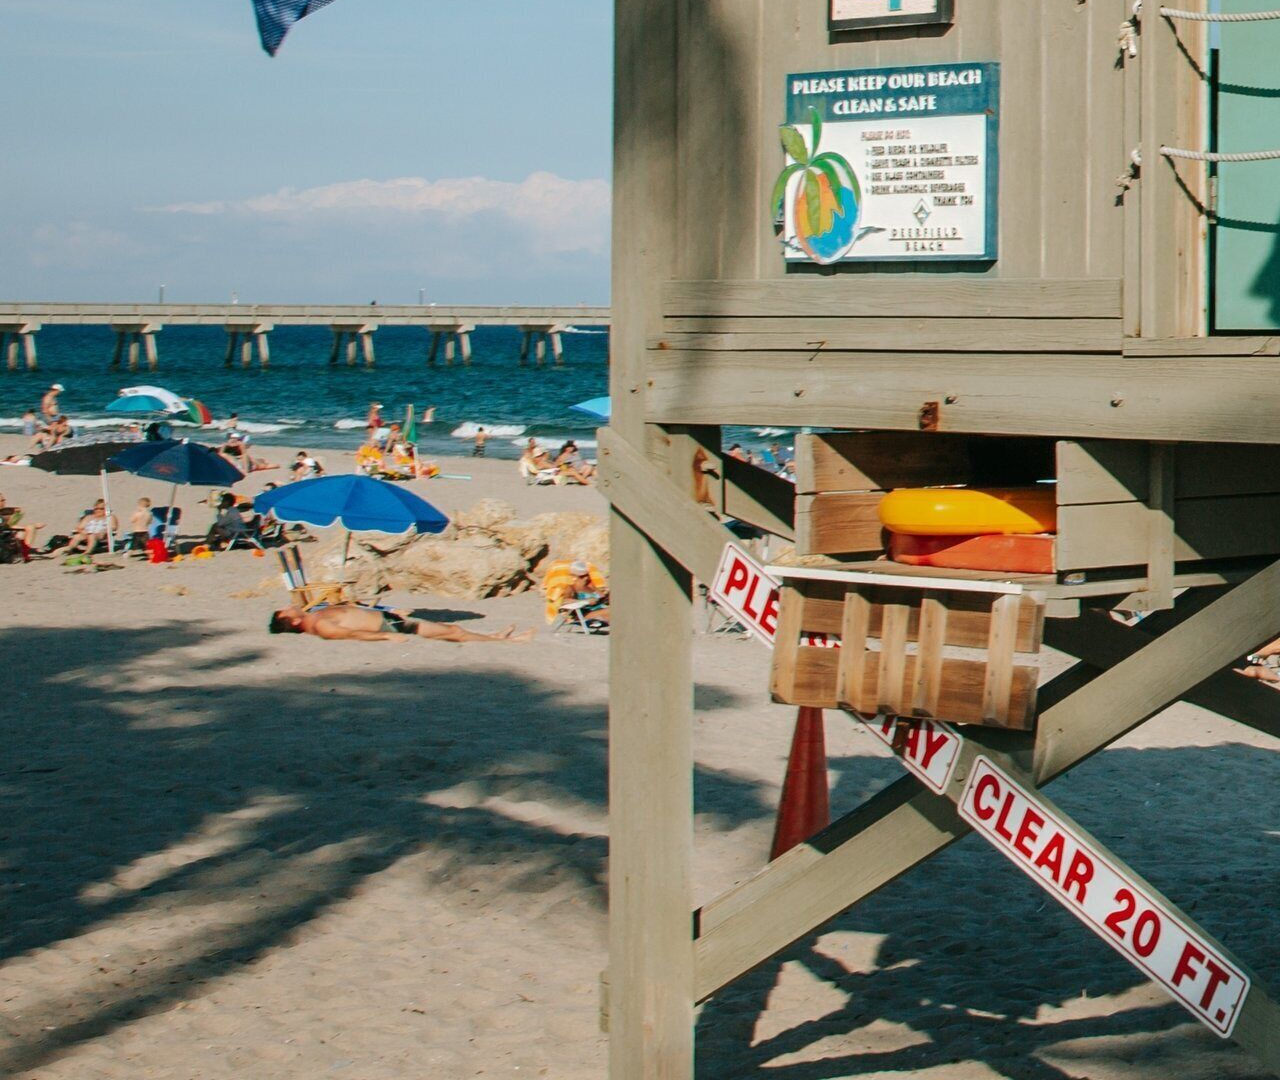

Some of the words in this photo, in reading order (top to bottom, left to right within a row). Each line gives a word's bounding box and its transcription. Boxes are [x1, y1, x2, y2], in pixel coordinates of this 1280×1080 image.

[792, 76, 846, 95] PLEASE
[847, 74, 888, 92] KEEP
[888, 72, 925, 90] OUR
[928, 69, 983, 87] BEACH
[833, 97, 885, 115] CLEAN
[884, 96, 898, 112] &
[899, 95, 938, 111] SAFE
[891, 227, 958, 239] DEERFIELD
[905, 242, 944, 252] BEACH
[974, 774, 1094, 904] CLEAR
[1104, 888, 1161, 958] 20
[1171, 941, 1230, 1024] FT.
